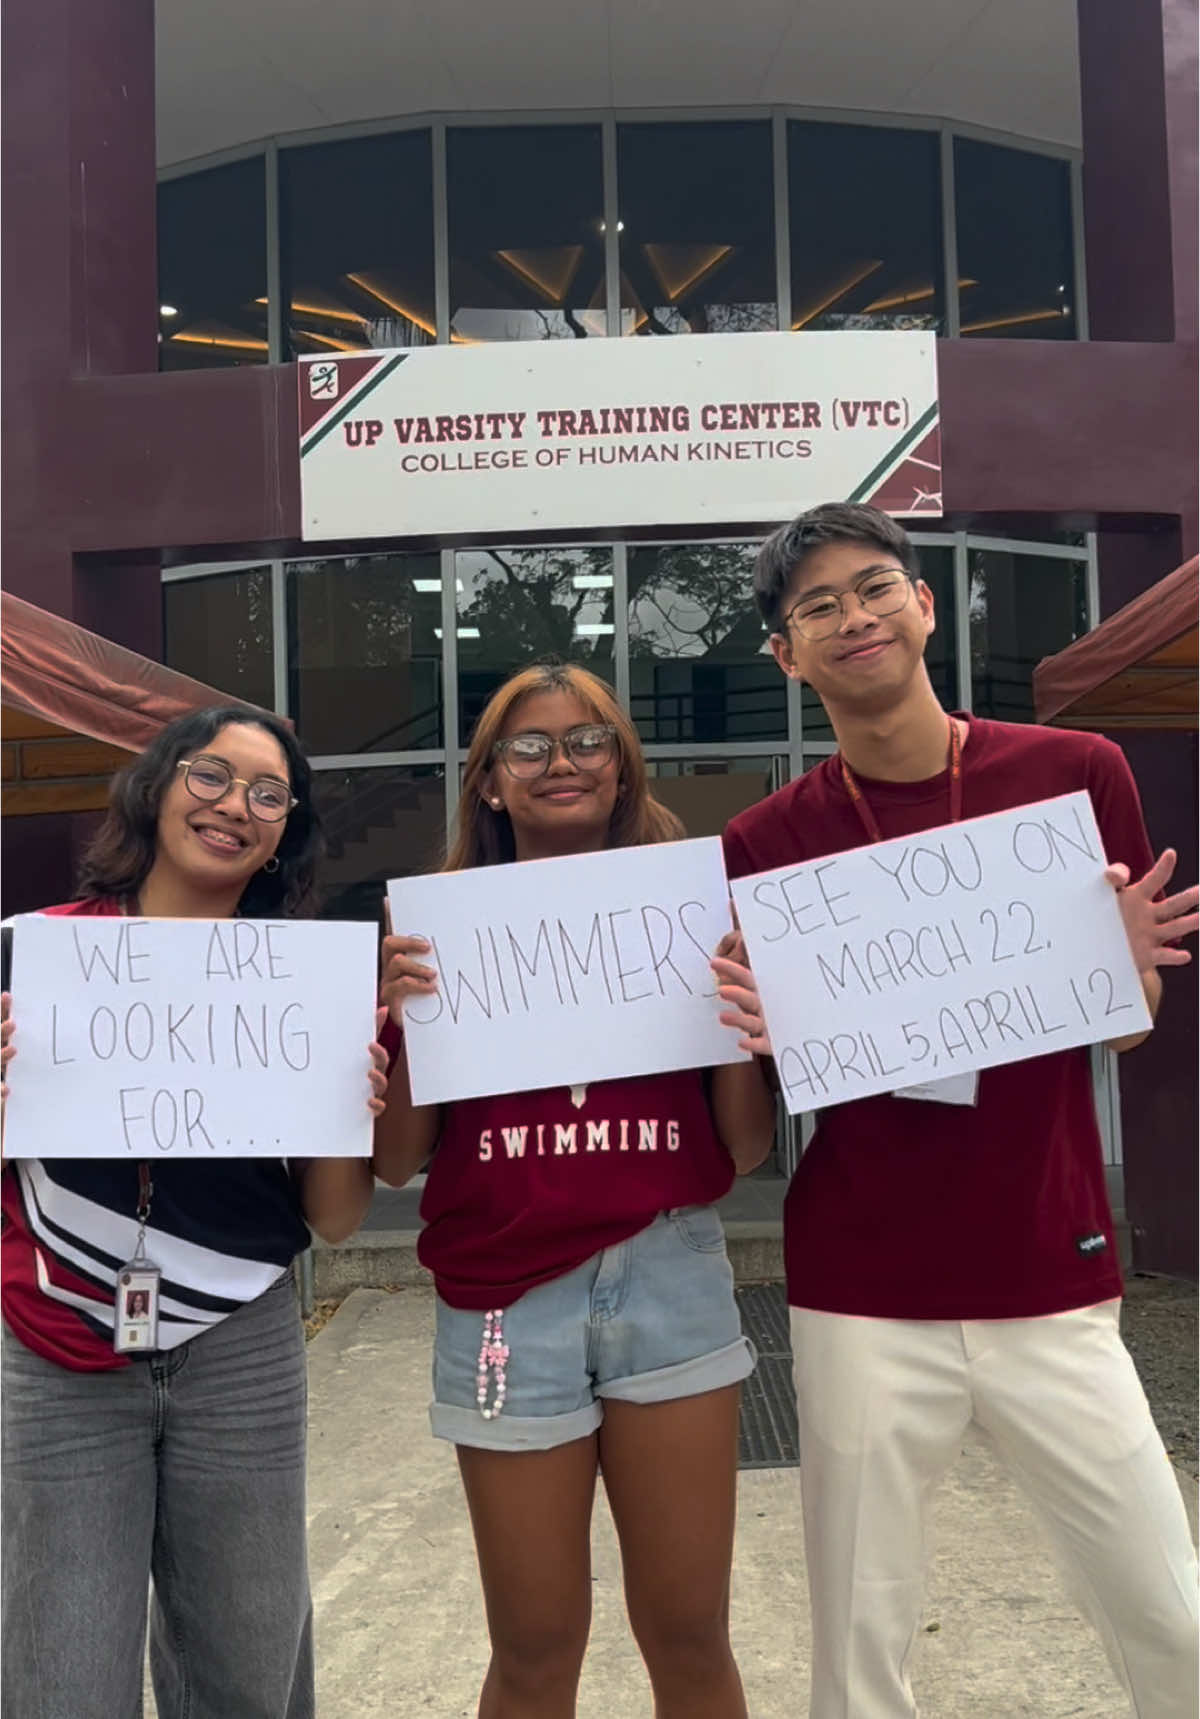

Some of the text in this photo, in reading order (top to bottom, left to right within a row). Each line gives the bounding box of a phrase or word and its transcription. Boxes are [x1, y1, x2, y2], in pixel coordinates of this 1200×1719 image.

[344, 397, 911, 447] UP VARSITY TRAINING CENTER (VTC)
[400, 439, 813, 474] COLLEGE OF HUMAN KINETICS
[752, 806, 1099, 943] SEE YOU ON
[72, 921, 293, 985] WE ARE
[816, 918, 971, 1001] MARCH
[51, 1001, 311, 1072] LOOKING
[779, 1031, 905, 1099] APRIL
[1069, 967, 1134, 1026] 12
[478, 1118, 681, 1162] SWIMMING
